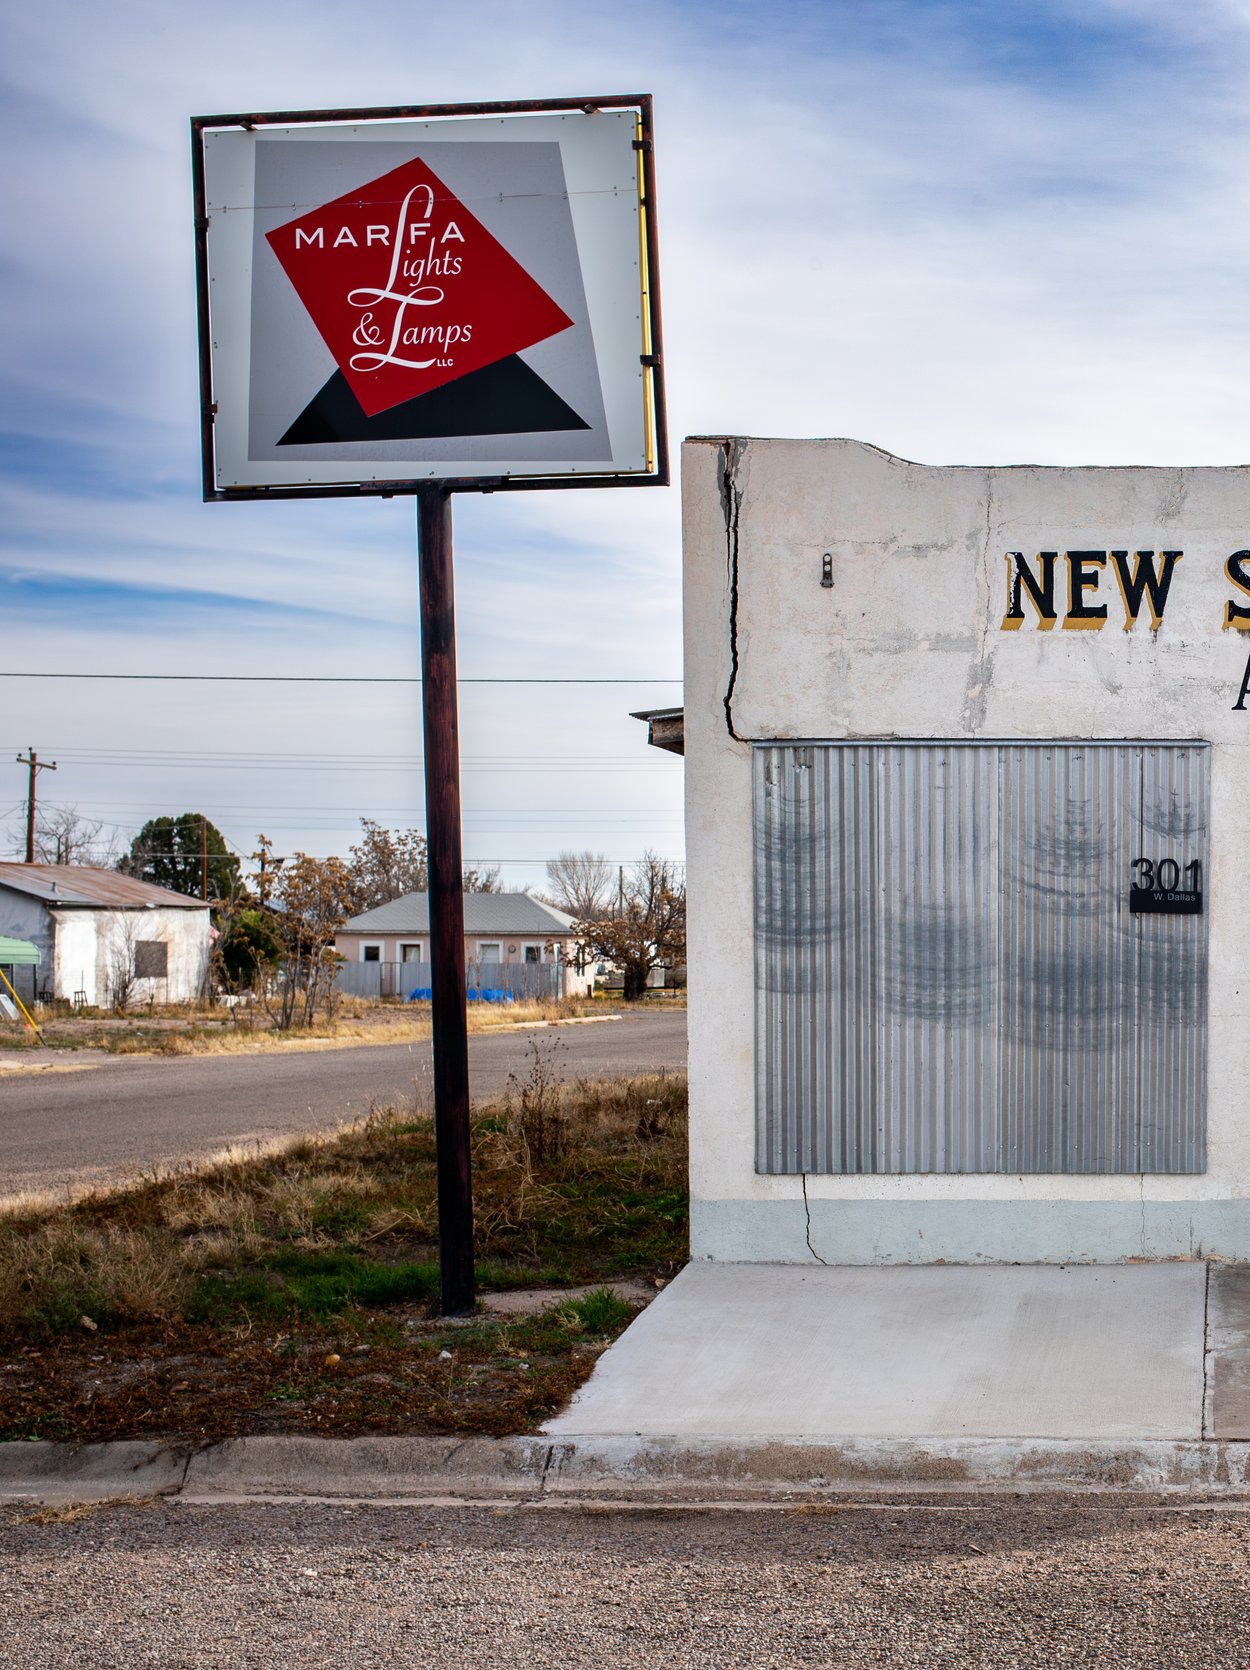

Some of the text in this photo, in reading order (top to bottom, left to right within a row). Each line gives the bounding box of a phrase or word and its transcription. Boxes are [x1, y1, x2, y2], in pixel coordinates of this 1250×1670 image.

[294, 221, 467, 250] MARFA
[347, 184, 463, 308] Lights
[349, 286, 473, 372] & Lamps
[436, 357, 454, 367] LLC
[1002, 550, 1184, 630] NEW
[1131, 858, 1200, 893] 301
[1167, 893, 1196, 901] Dallas
